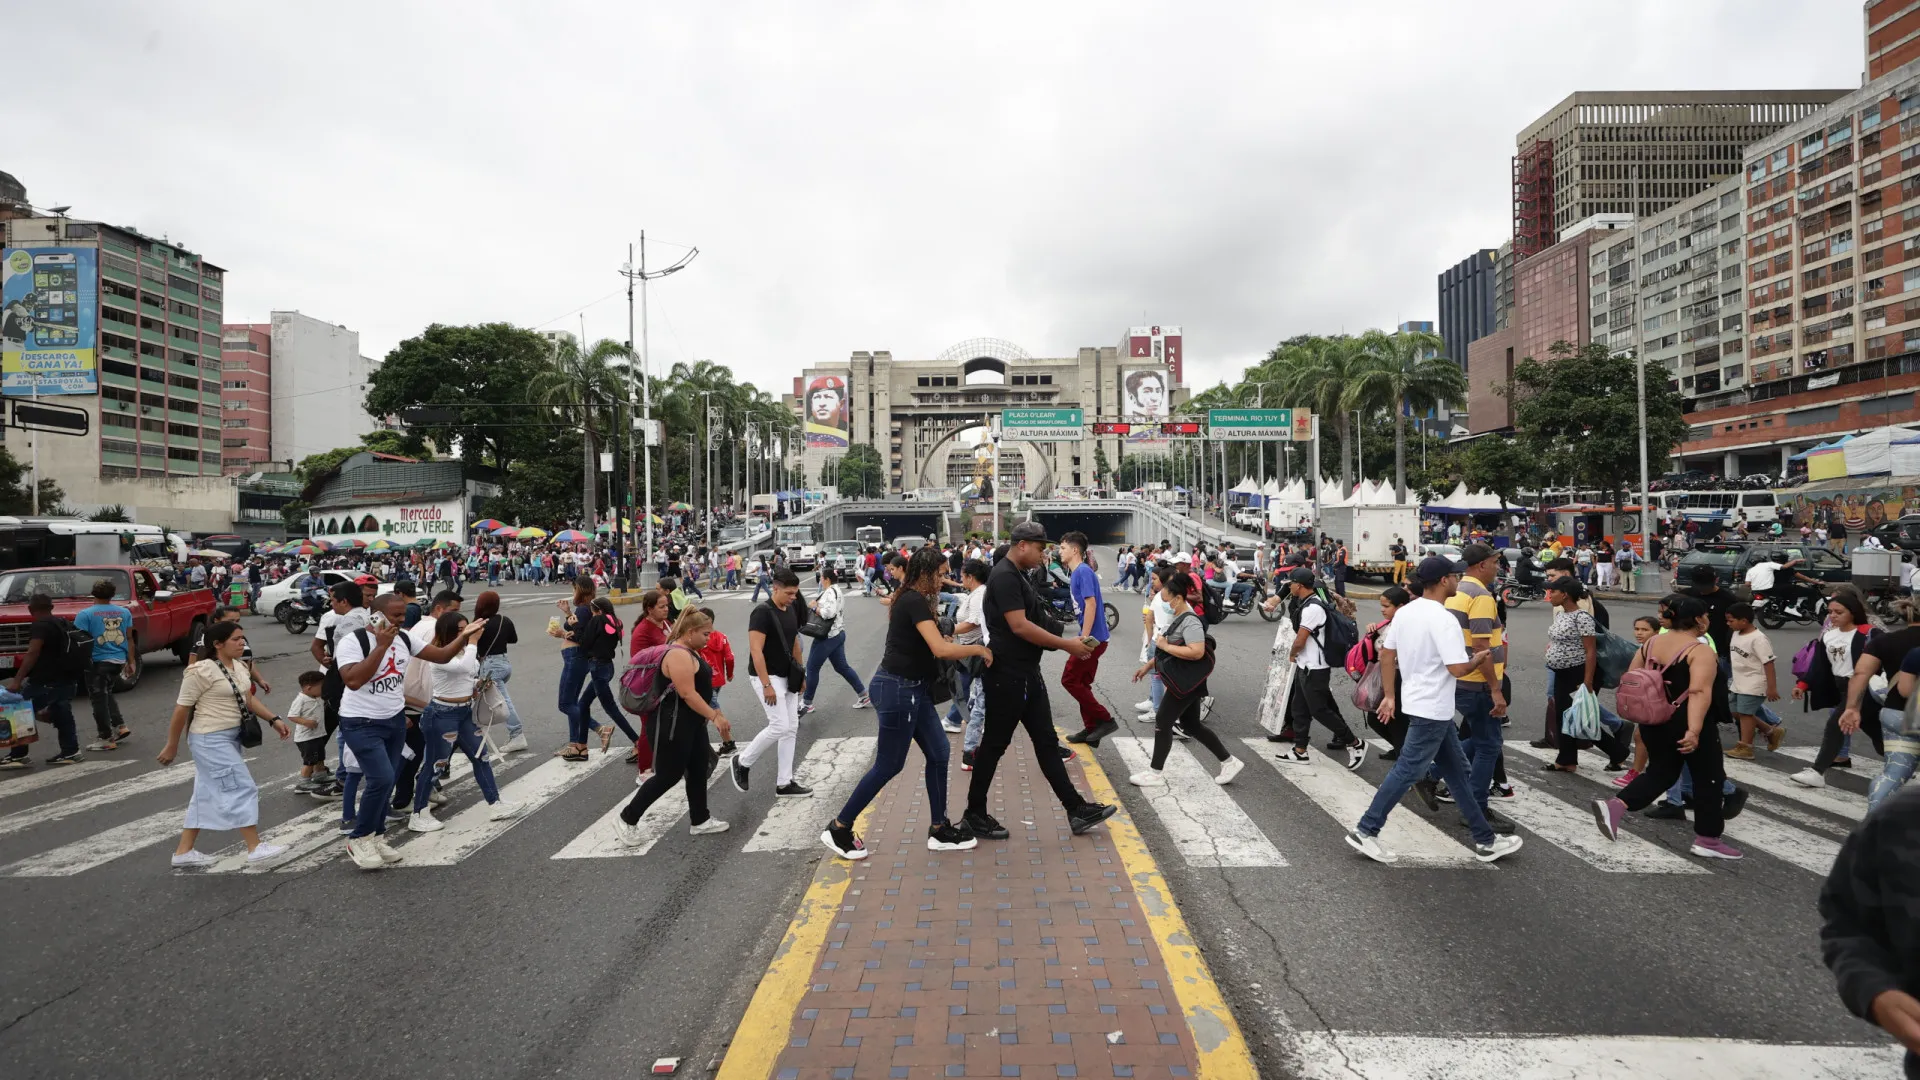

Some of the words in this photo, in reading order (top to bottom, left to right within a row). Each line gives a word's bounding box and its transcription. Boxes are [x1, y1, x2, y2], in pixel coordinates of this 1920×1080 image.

[1137, 347, 1145, 355] A
[28, 360, 61, 369] GANA
[64, 360, 83, 369] YA!
[1050, 428, 1079, 437] MÁXIMA
[1258, 428, 1288, 437] MÁXIMA
[394, 521, 419, 534] CRUZ
[422, 520, 454, 534] VERDE
